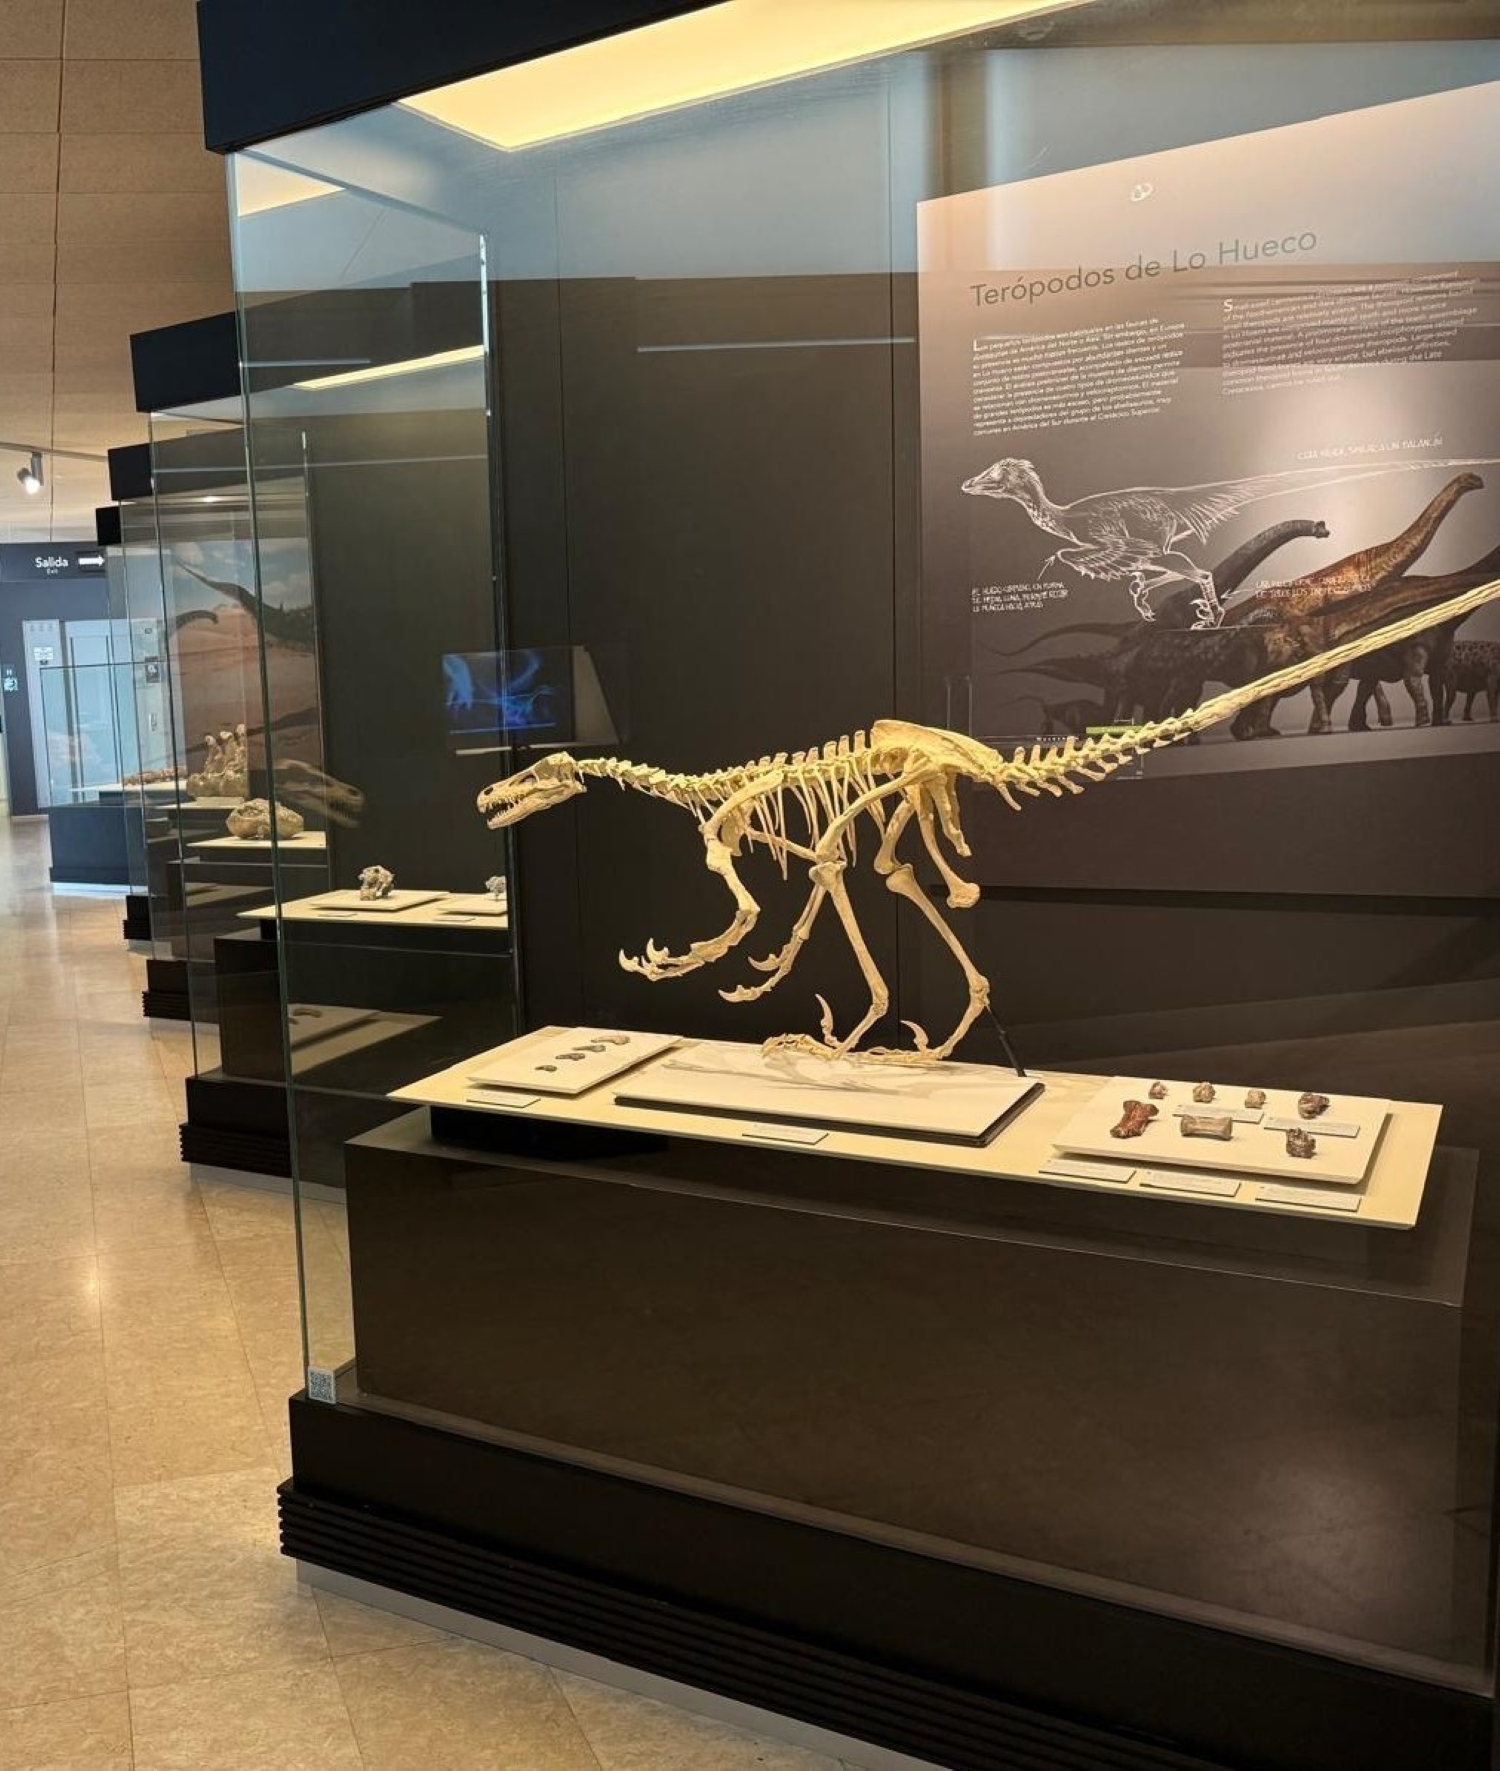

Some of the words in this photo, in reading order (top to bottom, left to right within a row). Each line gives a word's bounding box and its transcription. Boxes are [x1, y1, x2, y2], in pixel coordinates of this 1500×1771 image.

[970, 265, 1115, 306] Terópodos
[1125, 254, 1160, 280] de
[1173, 250, 1206, 272] Lo
[1219, 232, 1317, 265] Hueco
[35, 556, 68, 568] Salida
